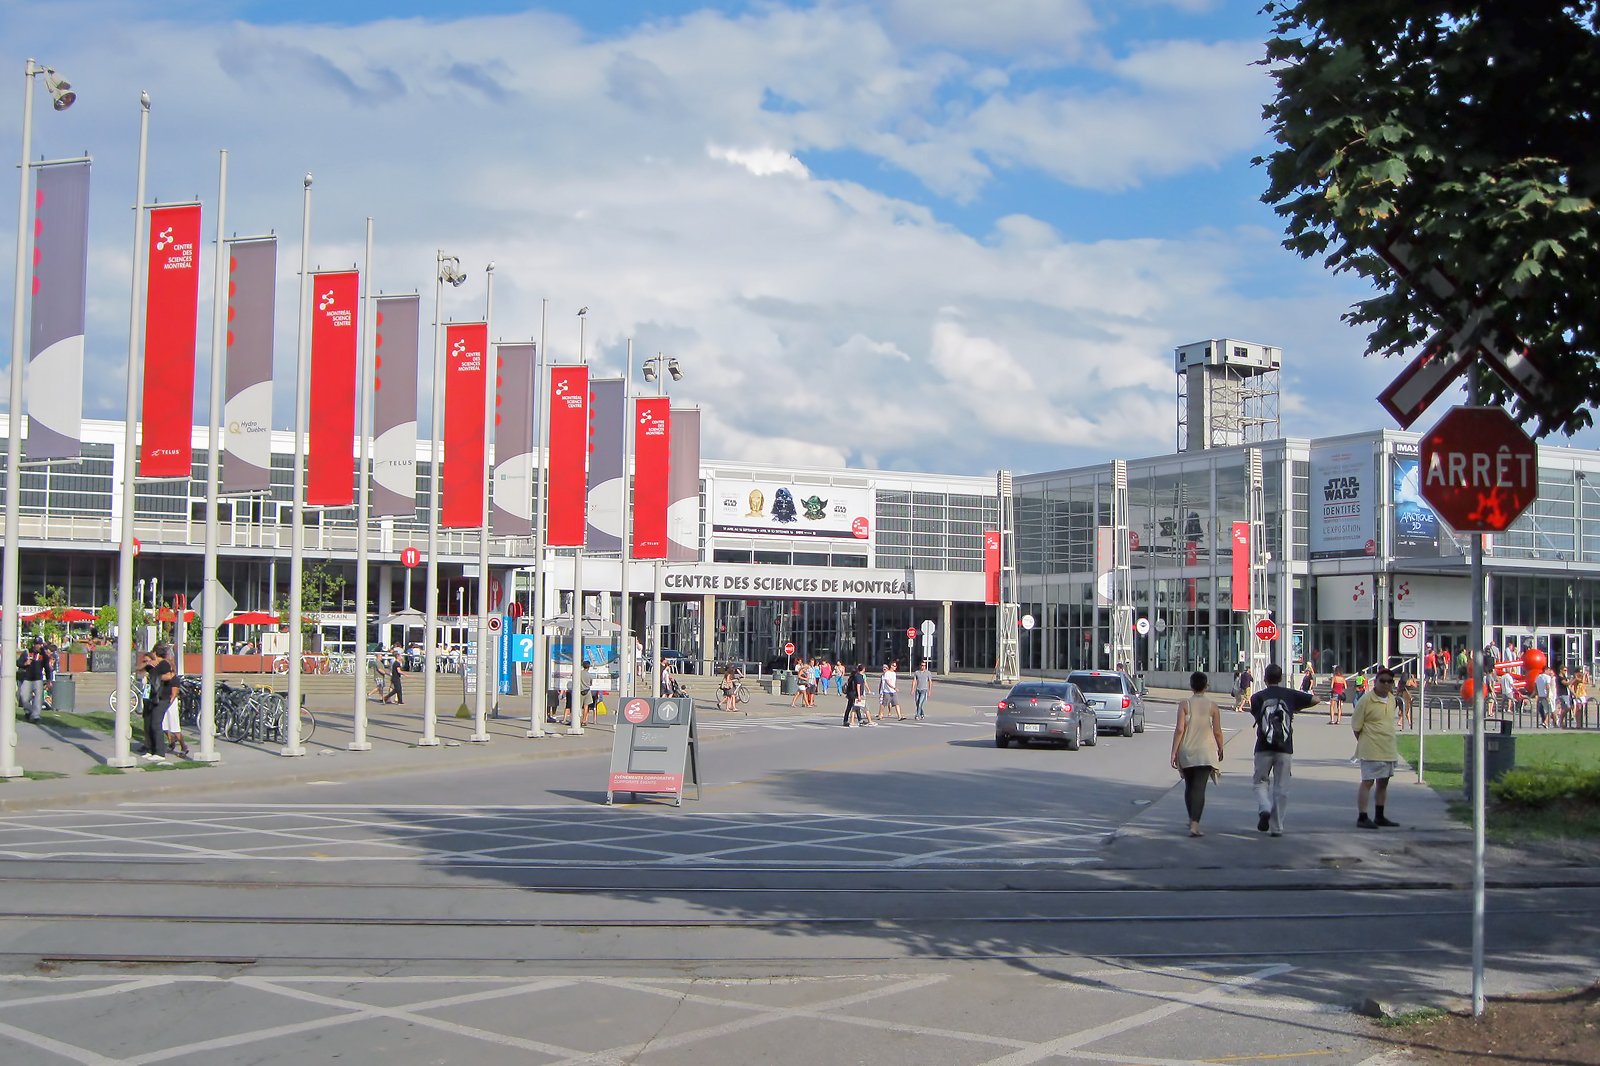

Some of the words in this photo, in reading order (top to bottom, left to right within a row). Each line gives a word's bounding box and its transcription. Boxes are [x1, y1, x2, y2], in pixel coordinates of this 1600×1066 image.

[1397, 444, 1418, 453] IMAX
[1426, 445, 1532, 488] ARRÊT
[1324, 477, 1359, 490] STAR
[1324, 487, 1359, 501] WARS
[1412, 521, 1421, 531] 3D
[664, 574, 720, 589] CENTRE
[724, 576, 750, 591] DES
[753, 577, 818, 592] SCIENCES
[821, 579, 839, 593] DE
[842, 579, 914, 595] MONTRÉAL
[1256, 625, 1275, 634] ARRÊT
